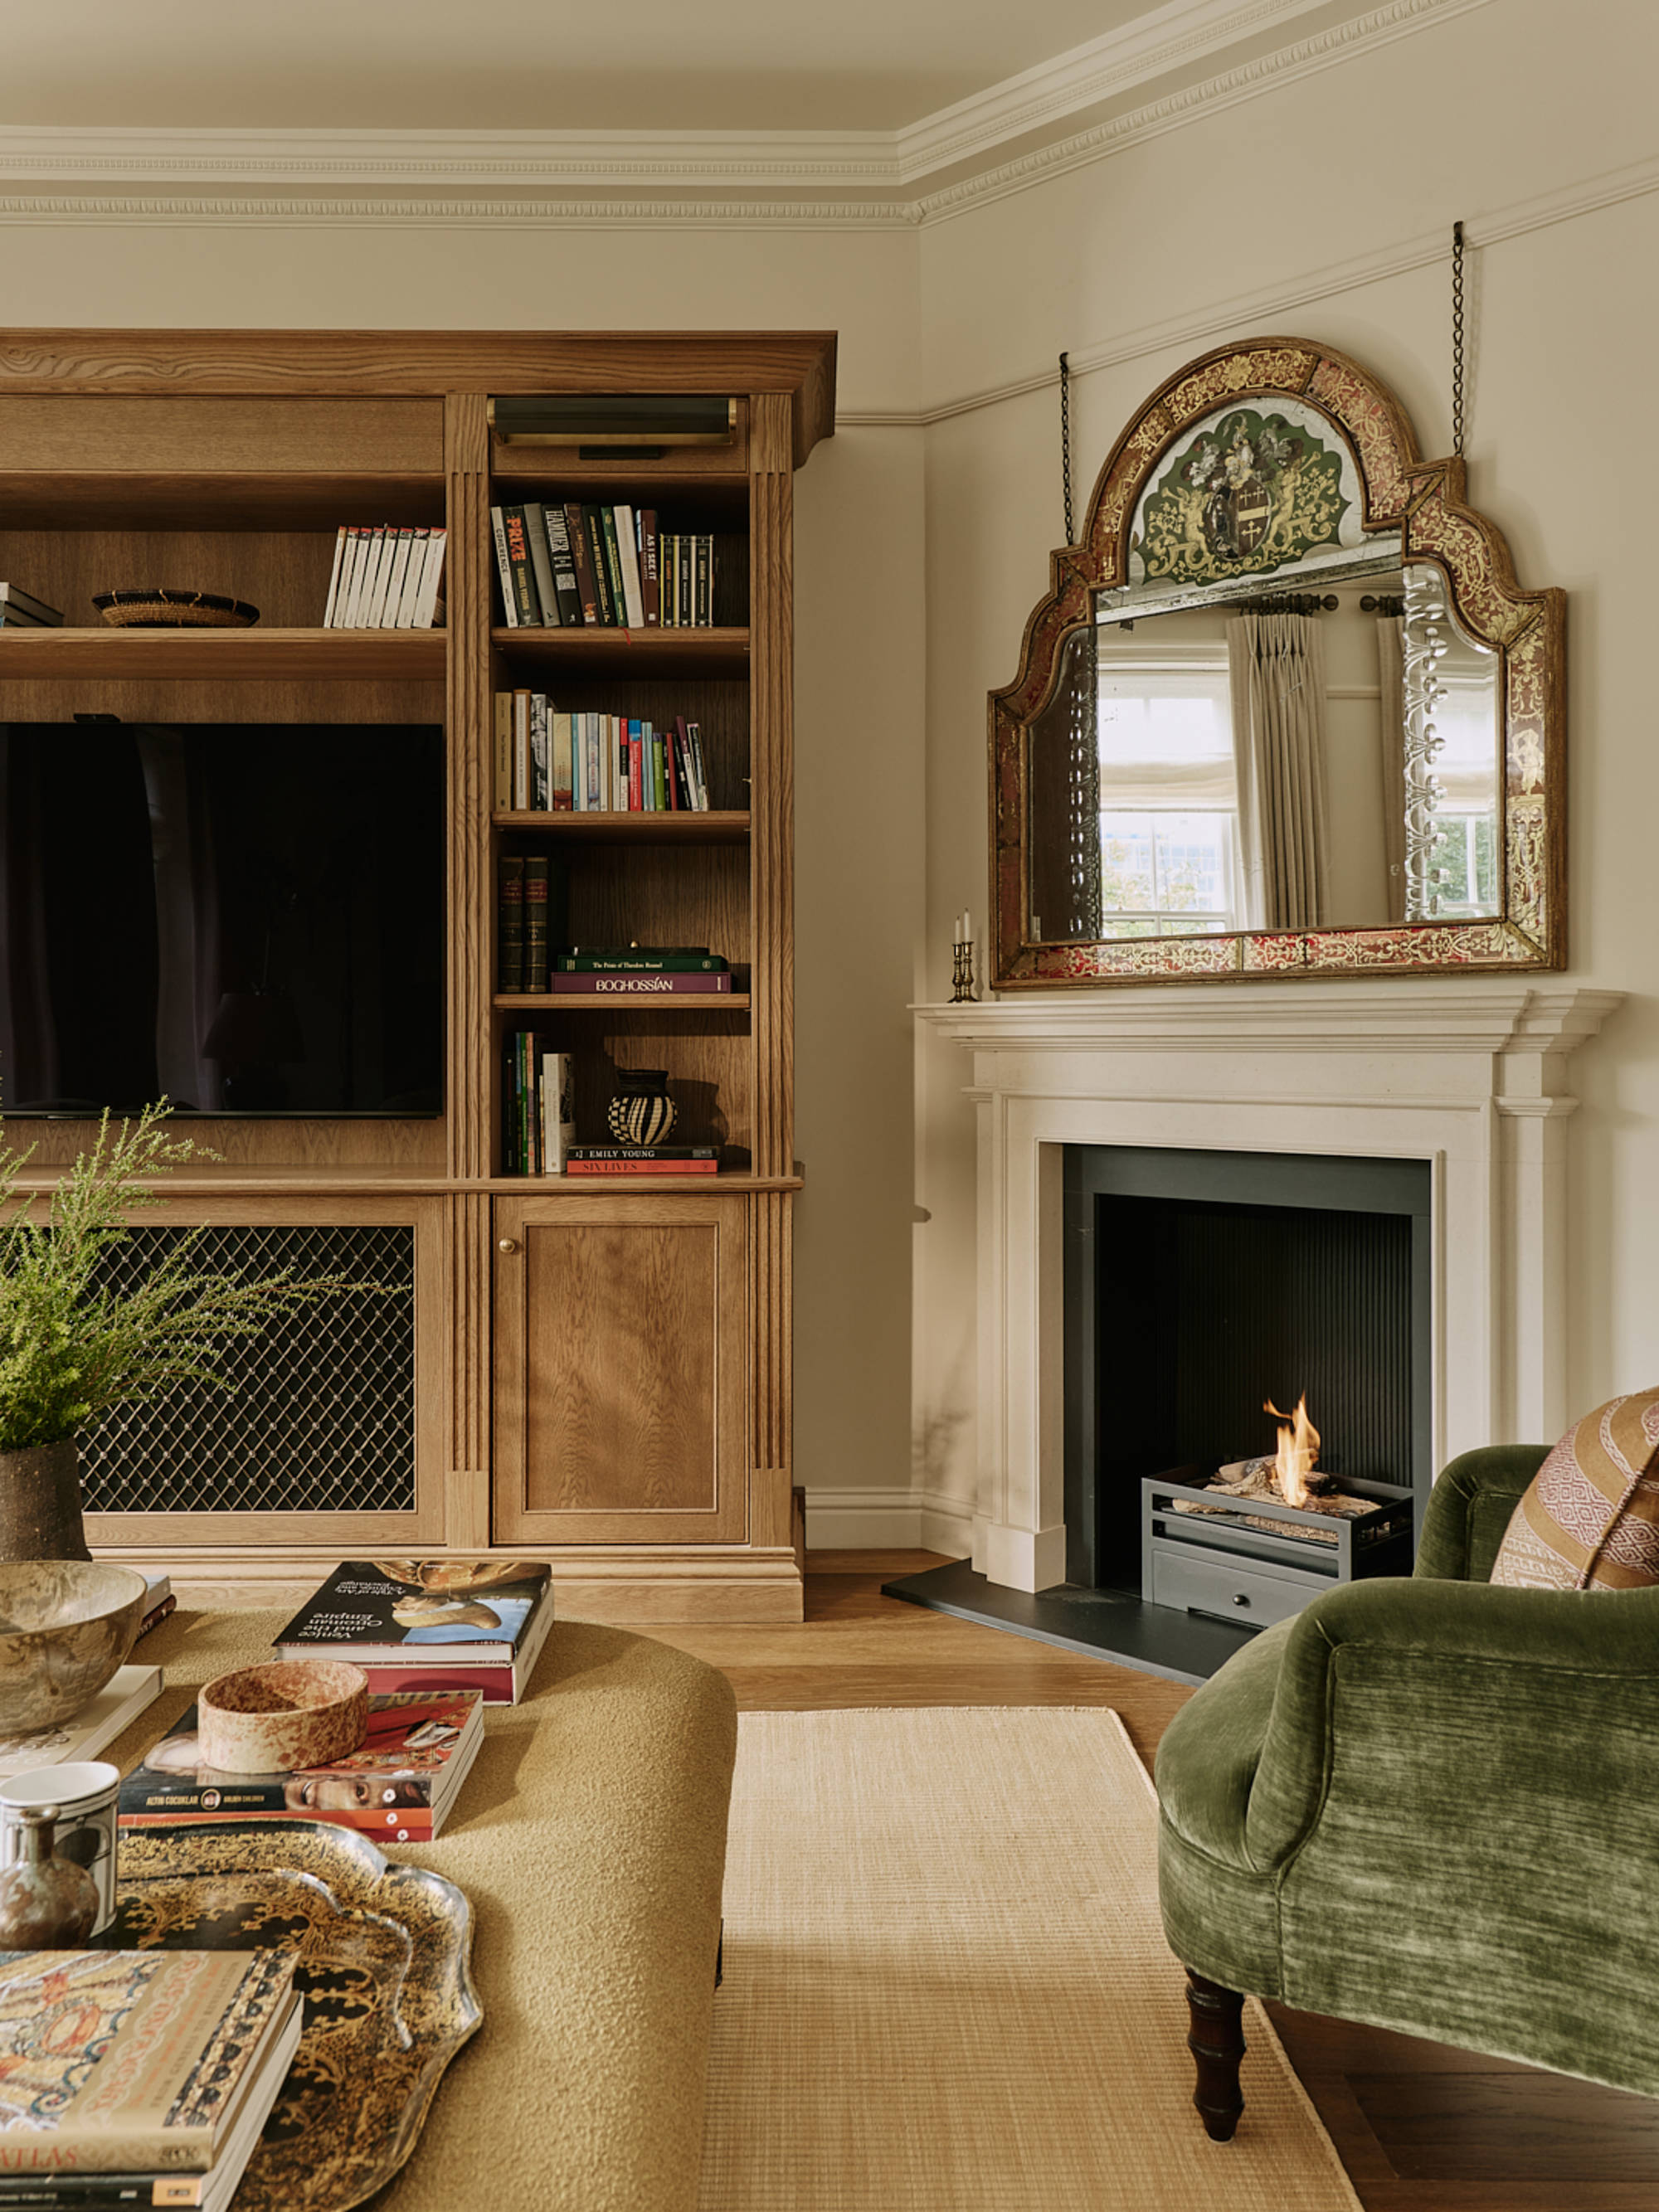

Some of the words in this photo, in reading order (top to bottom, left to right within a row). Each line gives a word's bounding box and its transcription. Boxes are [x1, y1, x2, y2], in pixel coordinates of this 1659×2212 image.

[507, 517, 527, 562] PRIZE
[646, 533, 655, 547] AS
[647, 553, 656, 571] SEE
[649, 571, 657, 581] IT
[590, 1150, 618, 1158] EMILY
[583, 1163, 603, 1171] SIX
[605, 1163, 638, 1171] LIVES
[313, 1612, 375, 1621] Empire
[309, 1618, 384, 1627] Ottoman
[298, 1631, 352, 1639] Venice
